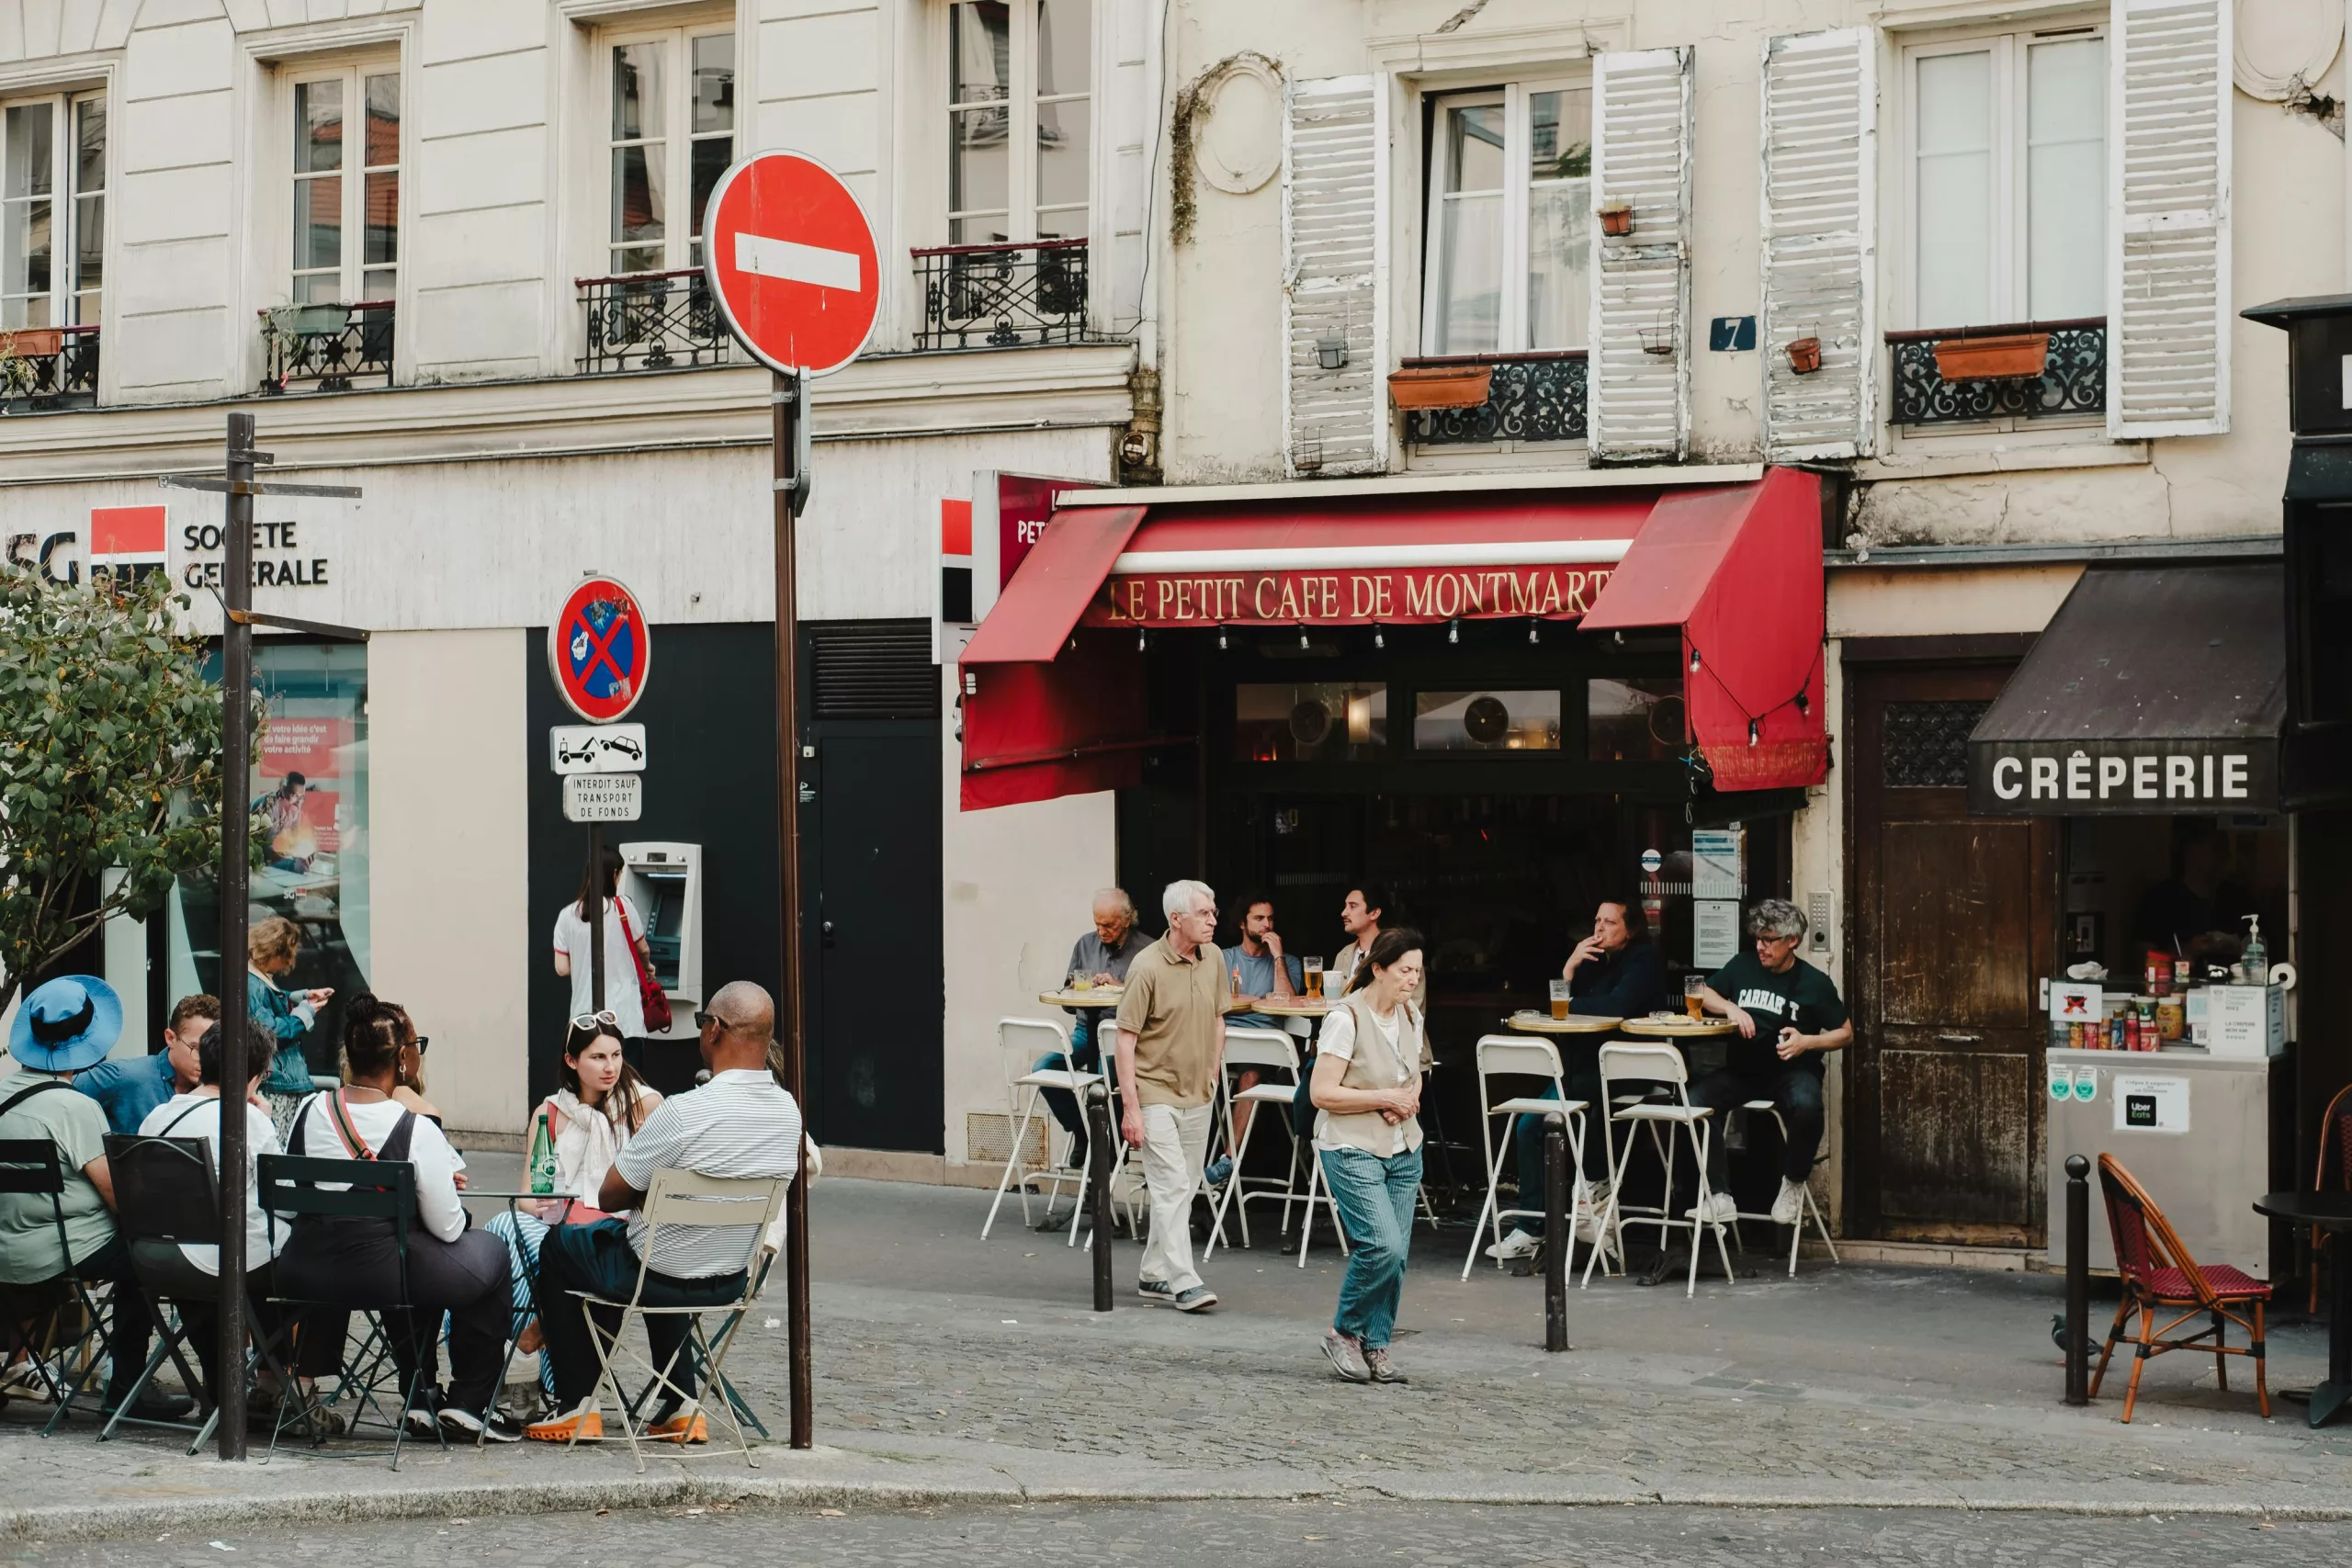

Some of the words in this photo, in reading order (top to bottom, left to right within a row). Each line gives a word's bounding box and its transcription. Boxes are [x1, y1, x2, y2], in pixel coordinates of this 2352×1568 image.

[1724, 319, 1742, 350] 7
[184, 522, 297, 550] SOETE
[1018, 520, 1048, 543] PET
[6, 532, 79, 590] SG
[184, 558, 328, 588] GERALE
[1108, 581, 1147, 620] LE
[1157, 579, 1244, 620] PETIT
[1255, 577, 1340, 619] CAFE
[1351, 575, 1394, 617] DE
[1405, 570, 1615, 616] MONTMART
[272, 725, 290, 733] votre
[292, 724, 308, 733] idée
[310, 724, 327, 733] c'est
[264, 735, 273, 743] de
[275, 735, 290, 743] faire
[292, 735, 319, 745] grandir
[284, 744, 311, 753] activité
[1993, 750, 2248, 800] CRÊPERIE
[573, 779, 611, 789] INTERDIT
[615, 779, 636, 789] SAUF
[578, 793, 632, 803] TRANSPORT
[581, 807, 593, 817] DE
[598, 807, 629, 817] FONDS
[283, 890, 295, 899] SG
[1738, 988, 1800, 1021] CARHART
[2132, 1102, 2151, 1111] Uber
[2132, 1111, 2151, 1119] Eats
